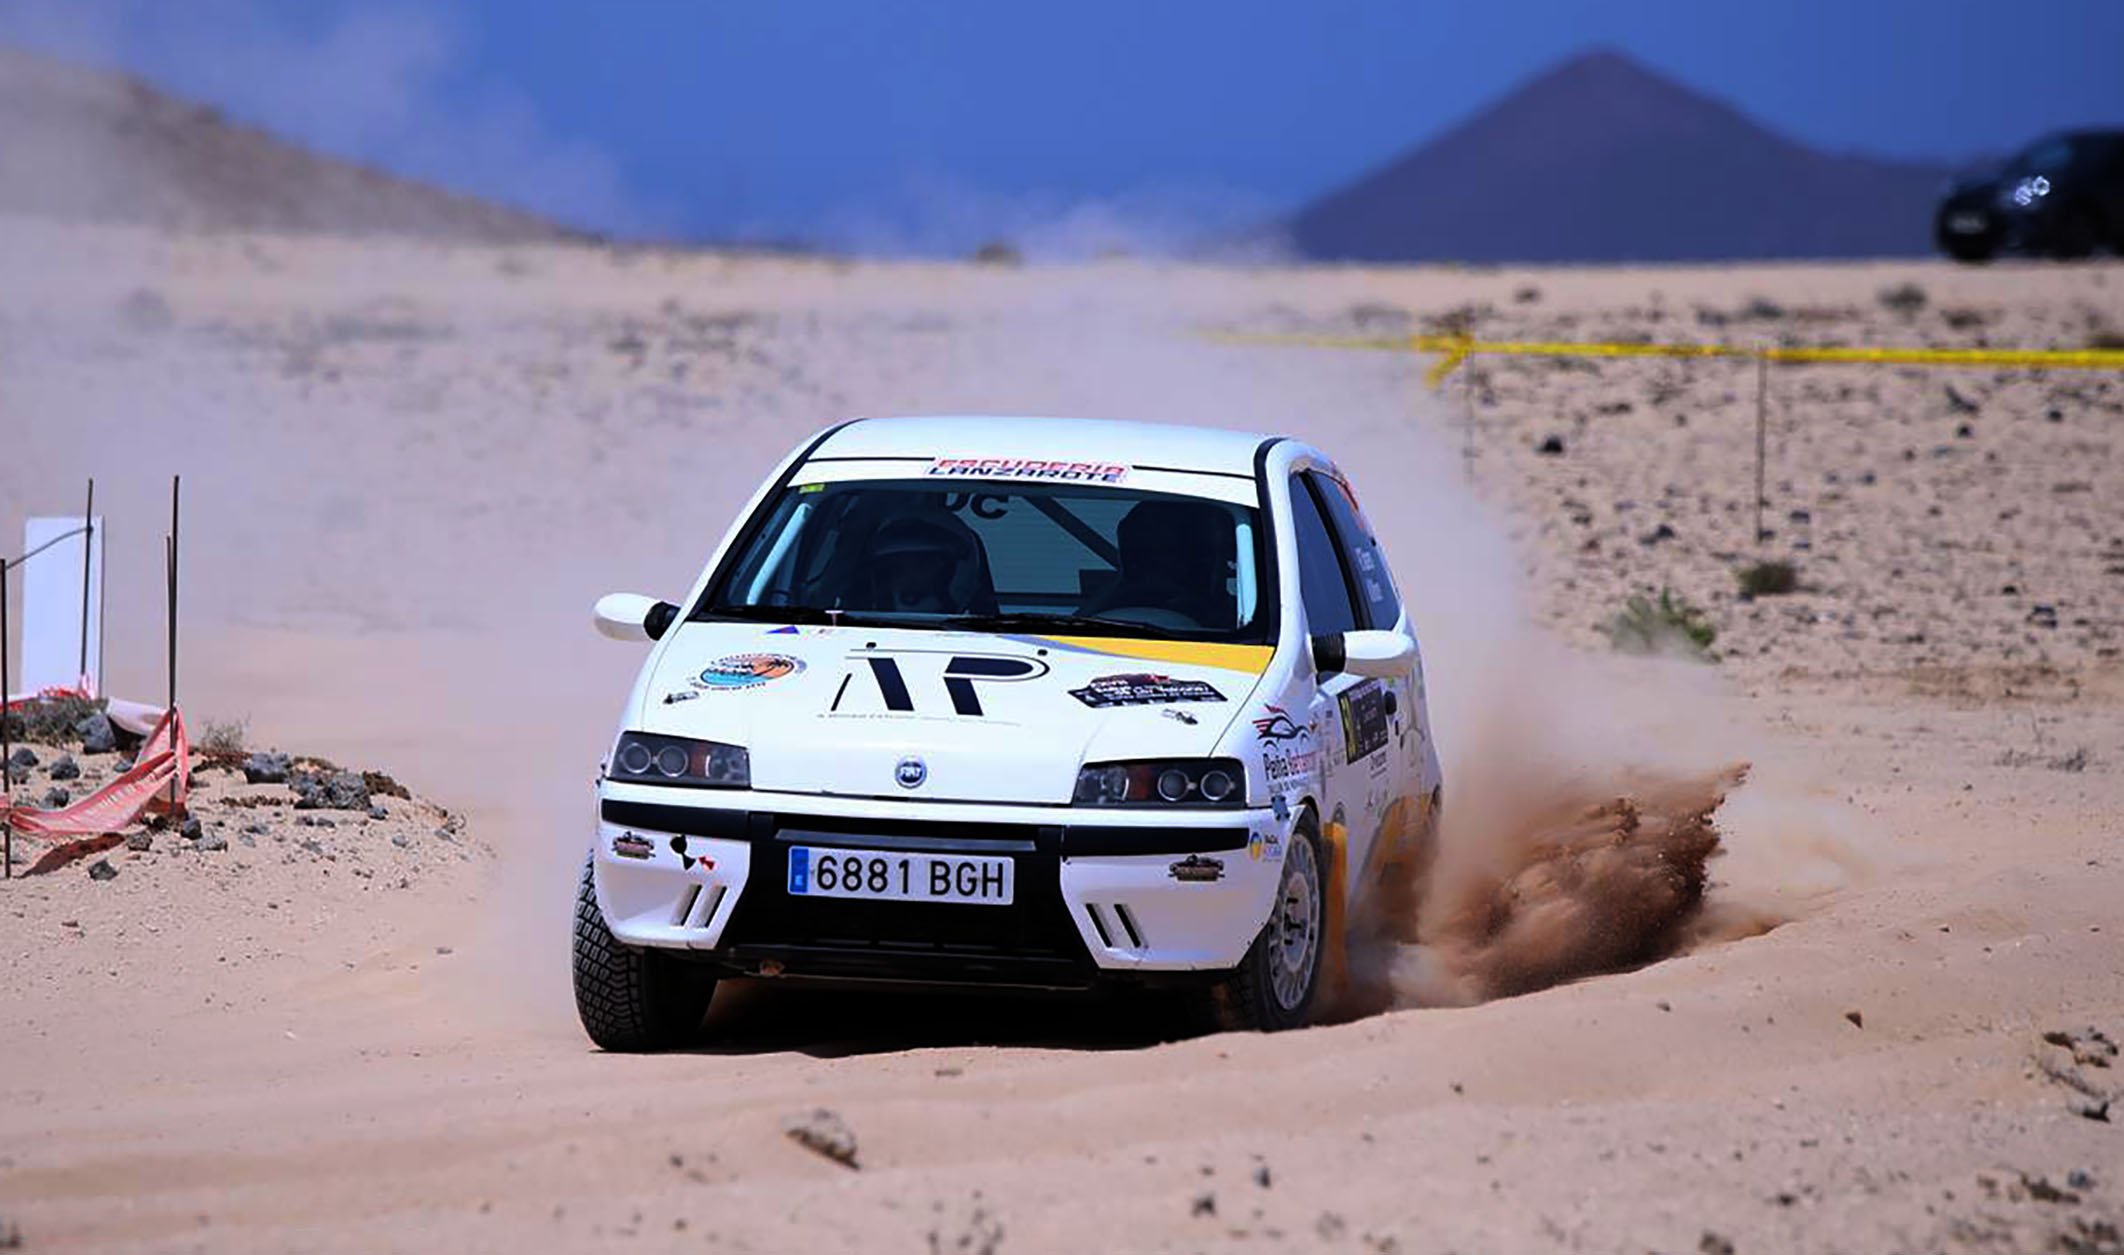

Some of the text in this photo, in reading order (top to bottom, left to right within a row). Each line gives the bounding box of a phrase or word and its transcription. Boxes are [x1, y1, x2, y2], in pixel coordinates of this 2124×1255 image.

[928, 466, 1121, 482] LANZAROTE
[816, 855, 1004, 898] 6881 BGH
